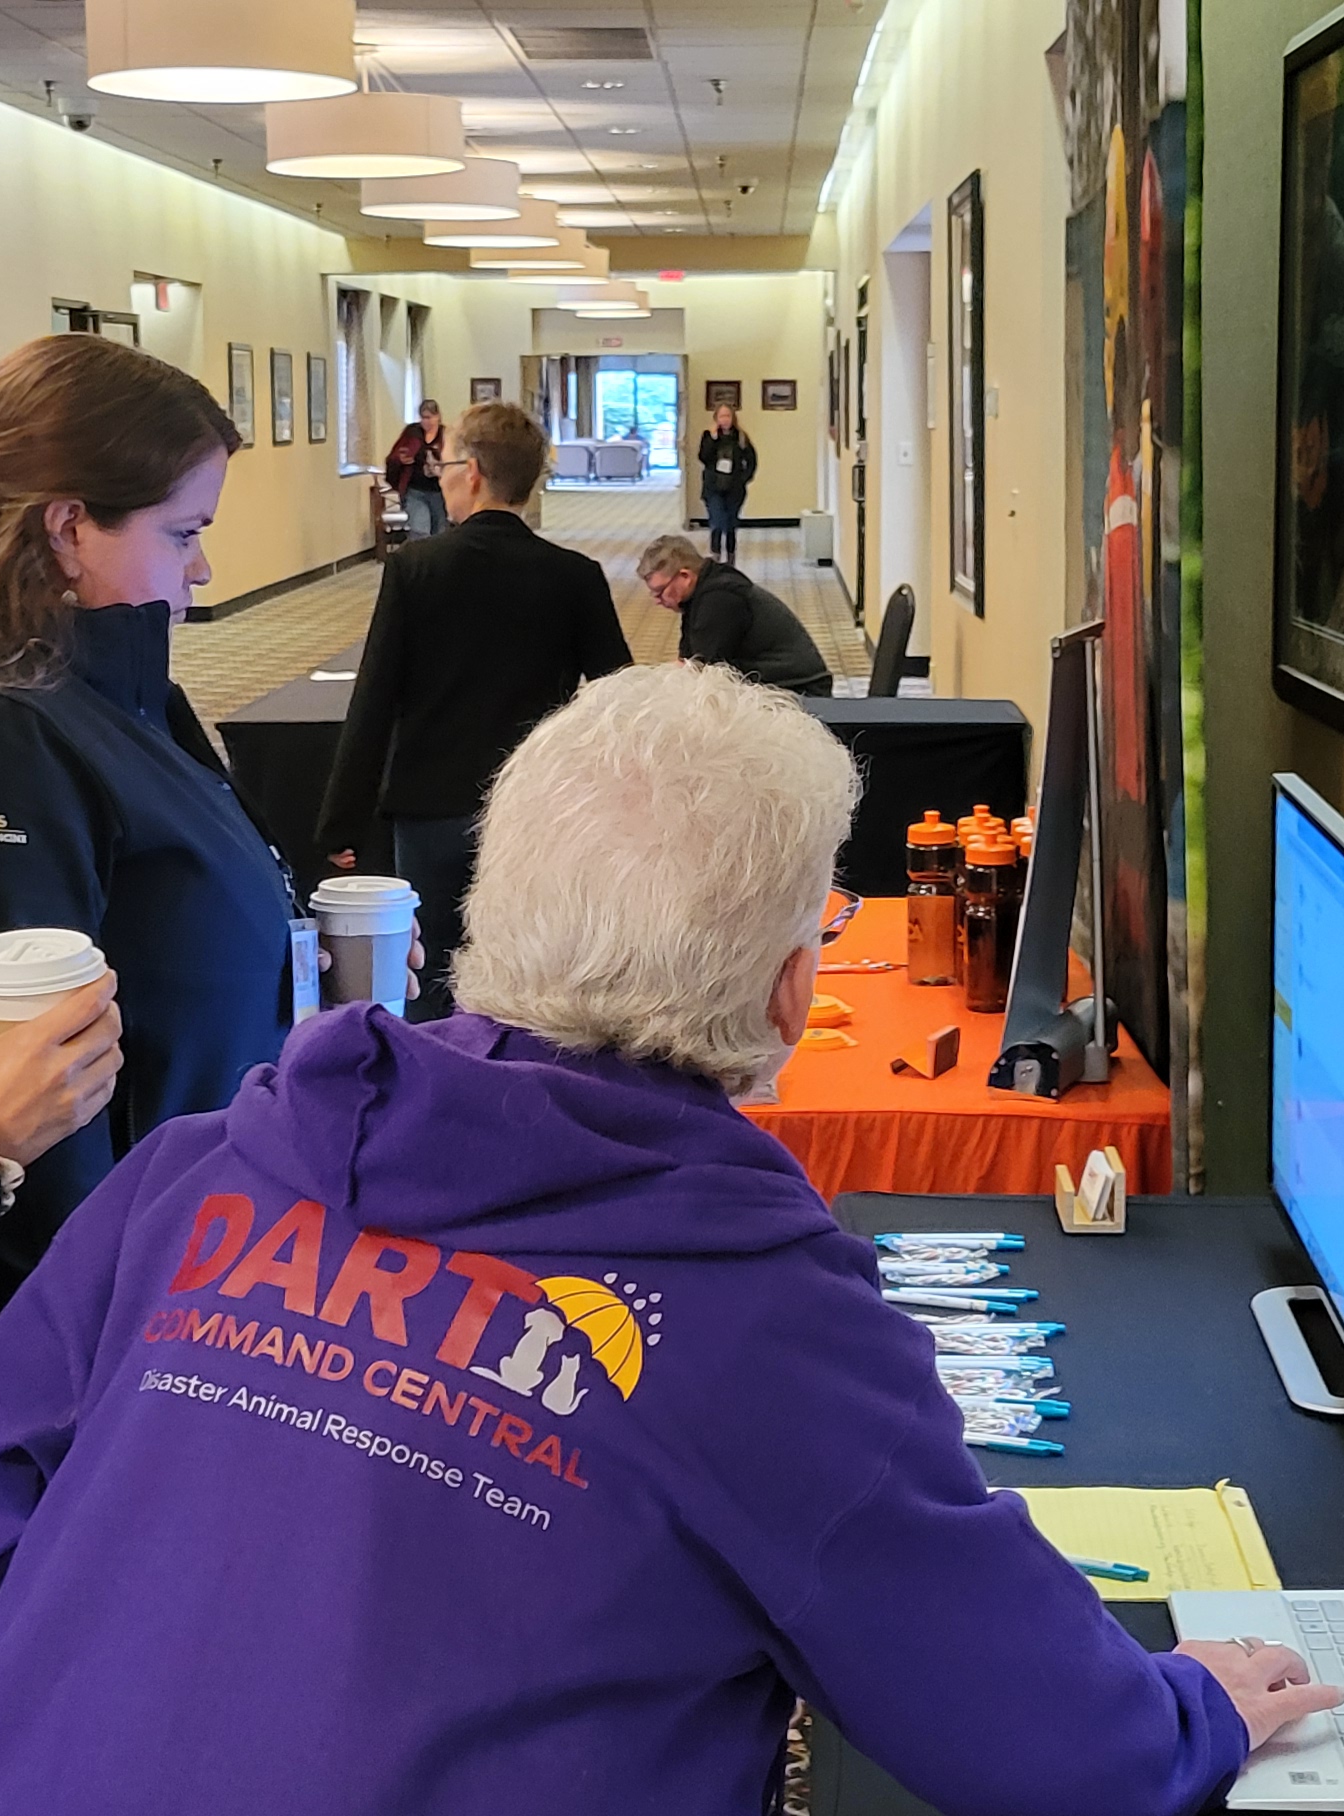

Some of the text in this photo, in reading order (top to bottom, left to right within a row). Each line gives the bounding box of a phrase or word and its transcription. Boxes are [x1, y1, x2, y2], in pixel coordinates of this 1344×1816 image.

[168, 1193, 542, 1370] DART
[139, 1368, 553, 1531] Disaster Animal Response Team
[144, 1308, 590, 1490] COMMAND CENTRAL
